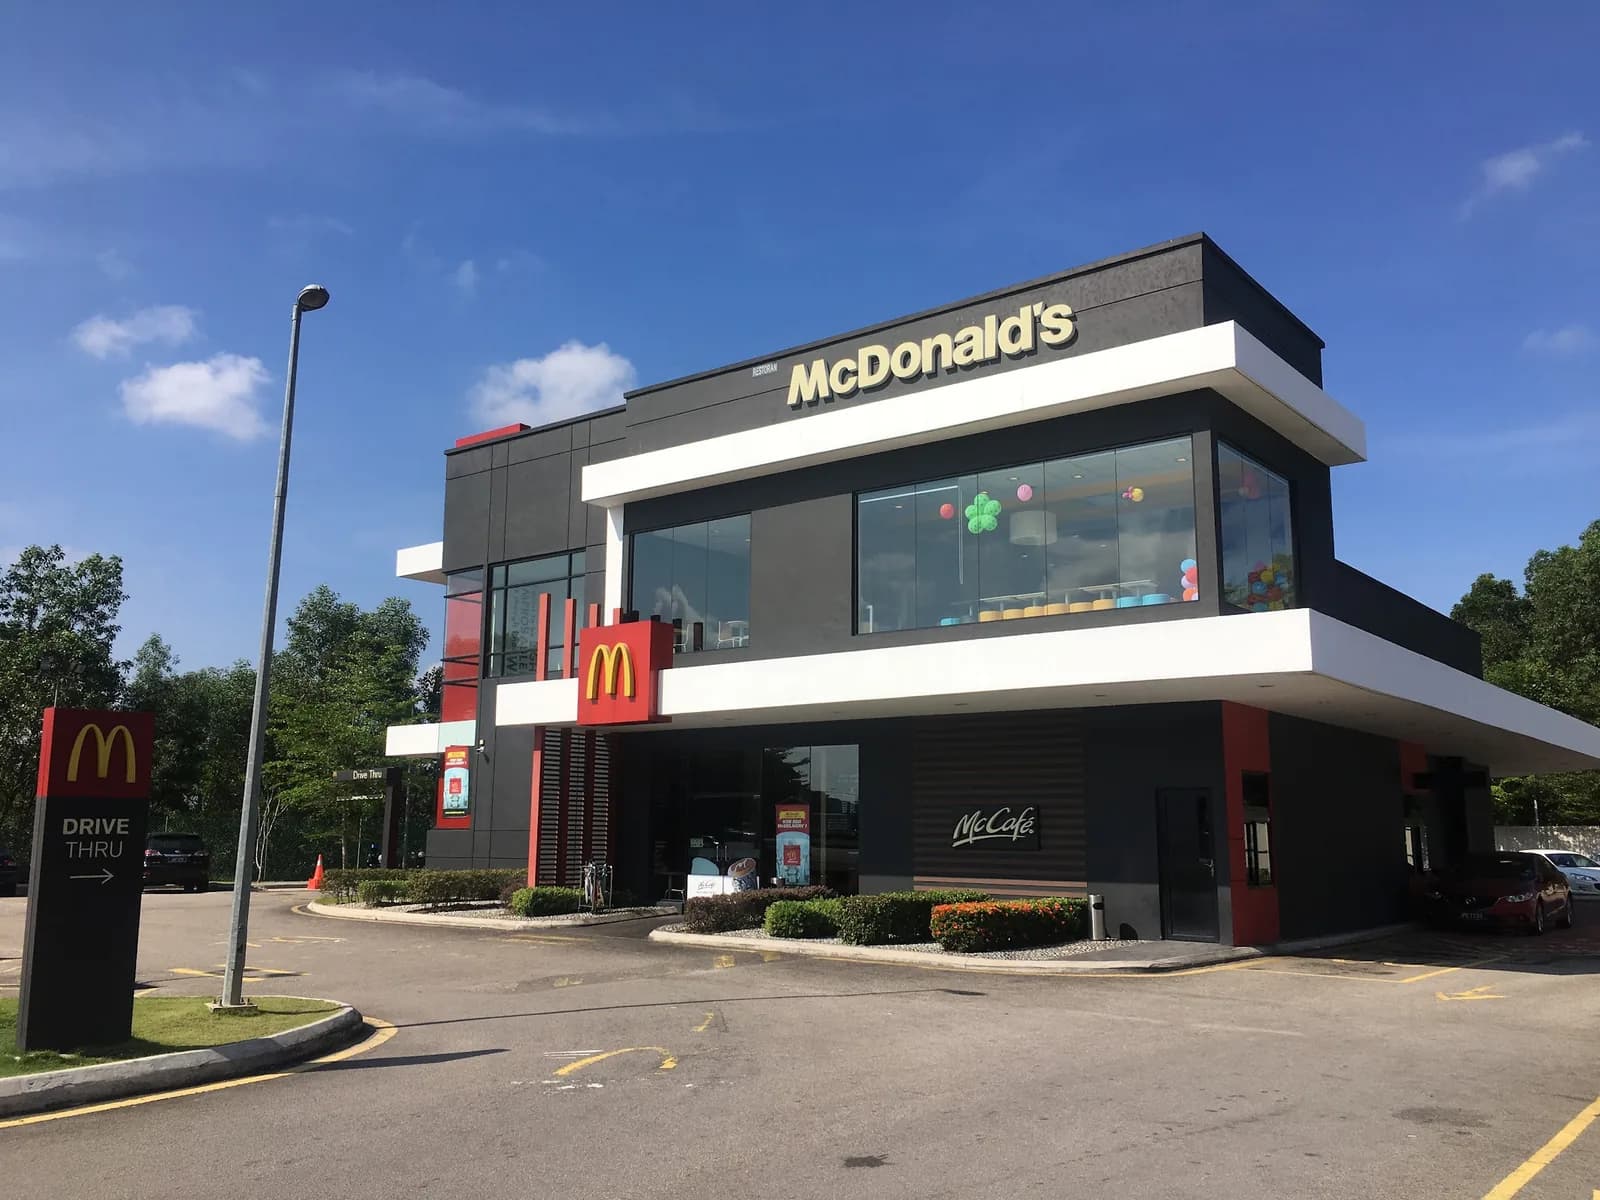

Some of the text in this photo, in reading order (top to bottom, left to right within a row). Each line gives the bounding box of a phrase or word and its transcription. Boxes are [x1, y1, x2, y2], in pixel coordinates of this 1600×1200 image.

[787, 302, 1075, 405] McDonald's
[752, 362, 778, 377] RESTORAN
[353, 769, 382, 780] Drive Thru
[63, 818, 129, 835] DRIVE
[952, 807, 1035, 847] McCafé
[65, 841, 123, 858] THRU
